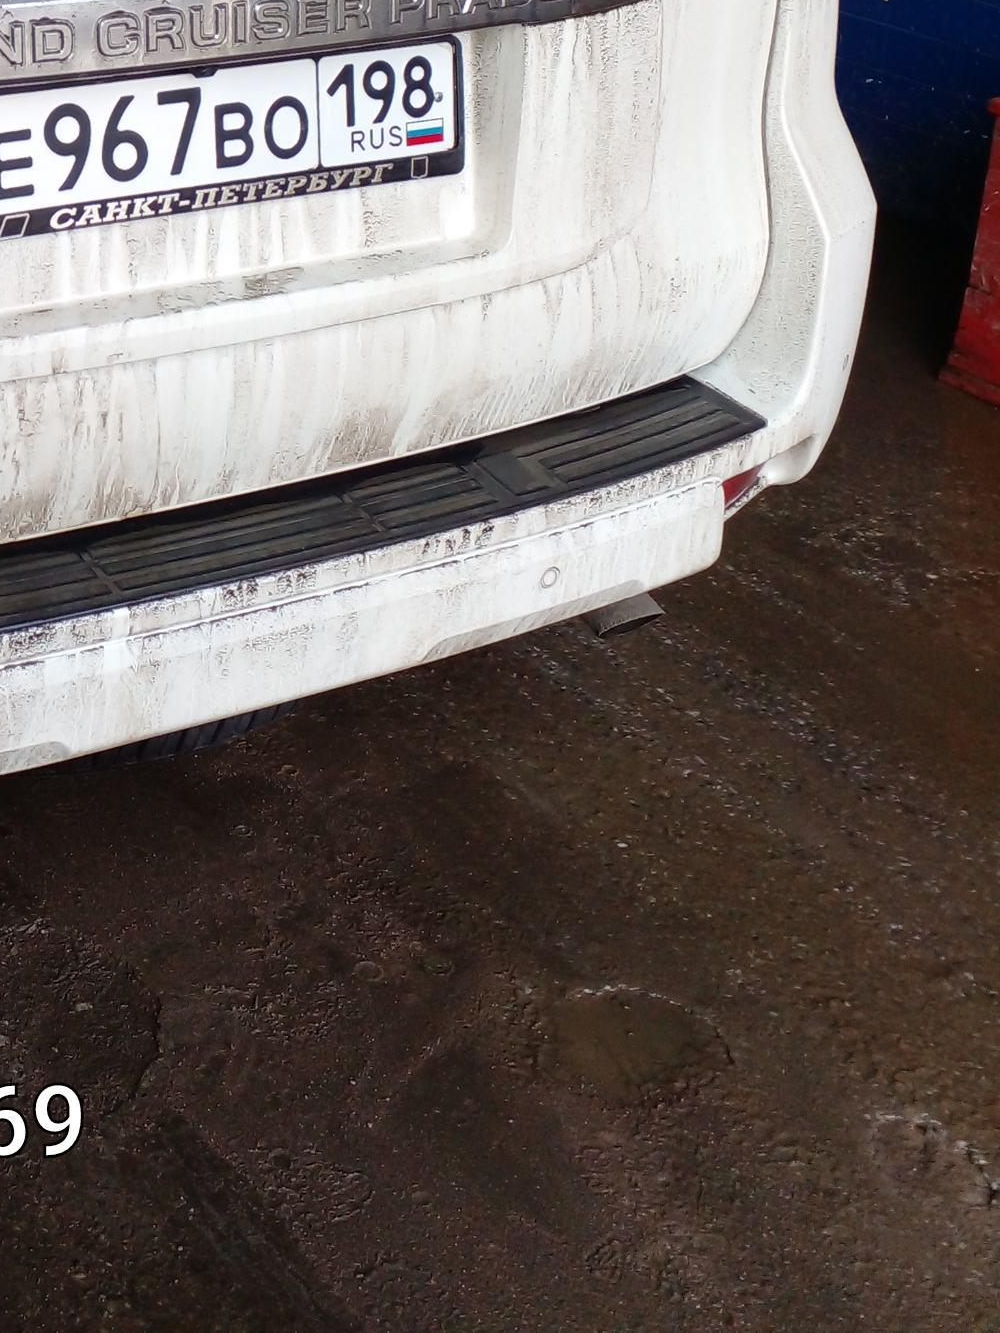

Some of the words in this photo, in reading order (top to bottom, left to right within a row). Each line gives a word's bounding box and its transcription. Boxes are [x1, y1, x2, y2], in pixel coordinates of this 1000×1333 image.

[326, 55, 436, 127] 198
[350, 127, 403, 154] RUS
[48, 163, 395, 231] САНКТ-ПЕТЕРБУРГ
